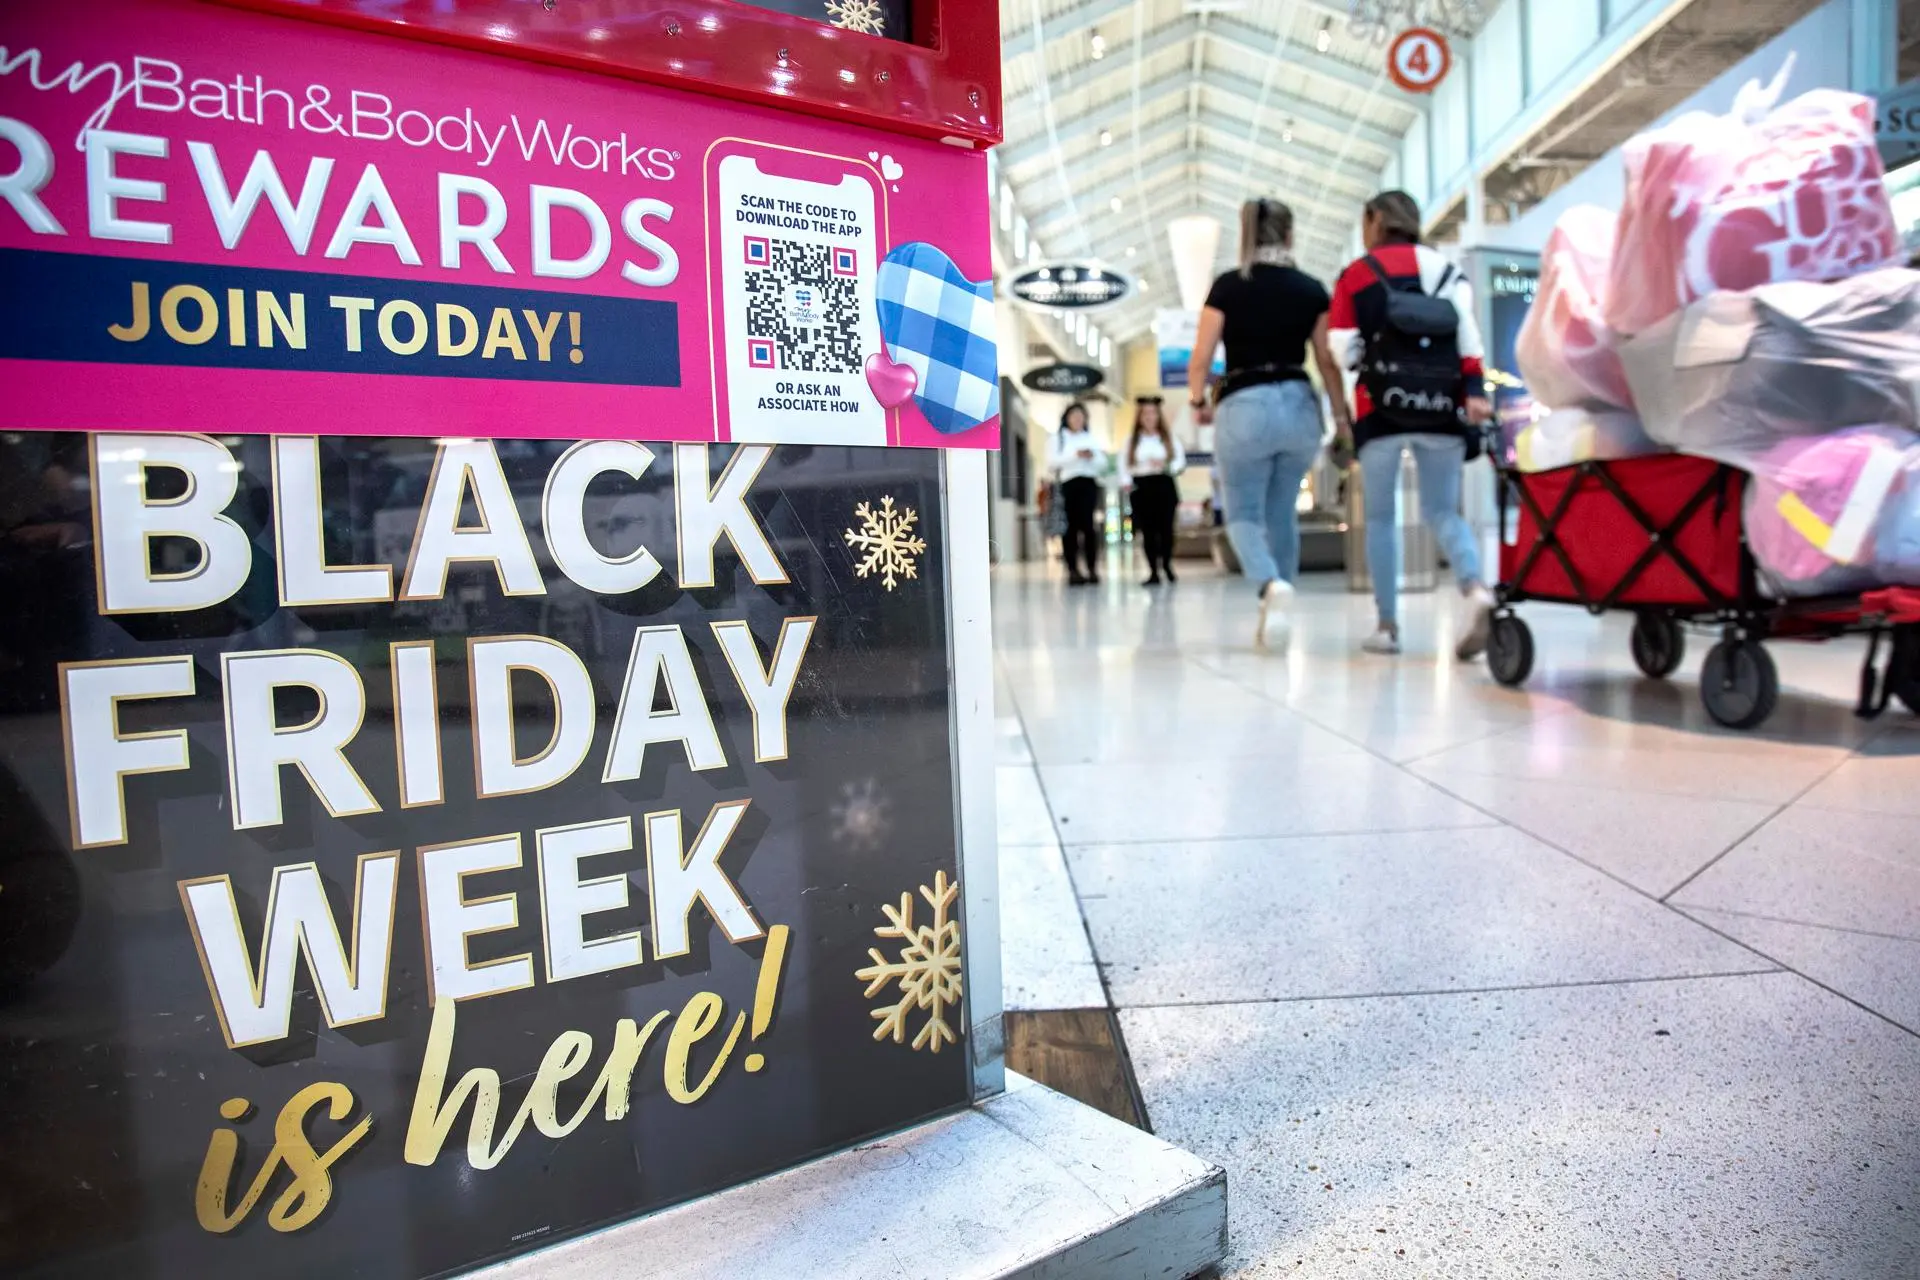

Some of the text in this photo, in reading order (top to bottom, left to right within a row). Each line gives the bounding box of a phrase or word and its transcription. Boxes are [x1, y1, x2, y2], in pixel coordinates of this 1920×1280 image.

[1406, 43, 1430, 76] 4
[736, 209, 862, 237] DOWNLOAD THE APP
[741, 194, 857, 222] SCAN THE CODE TO
[107, 281, 583, 364] JOIN TODAY!
[757, 397, 859, 413] ASSOCIATE HOW
[775, 382, 841, 397] OR ASK AN
[89, 434, 792, 615] BLACK
[57, 615, 818, 850] FRIDAY
[176, 798, 770, 1050] WEEK
[195, 924, 791, 1233] is here!
